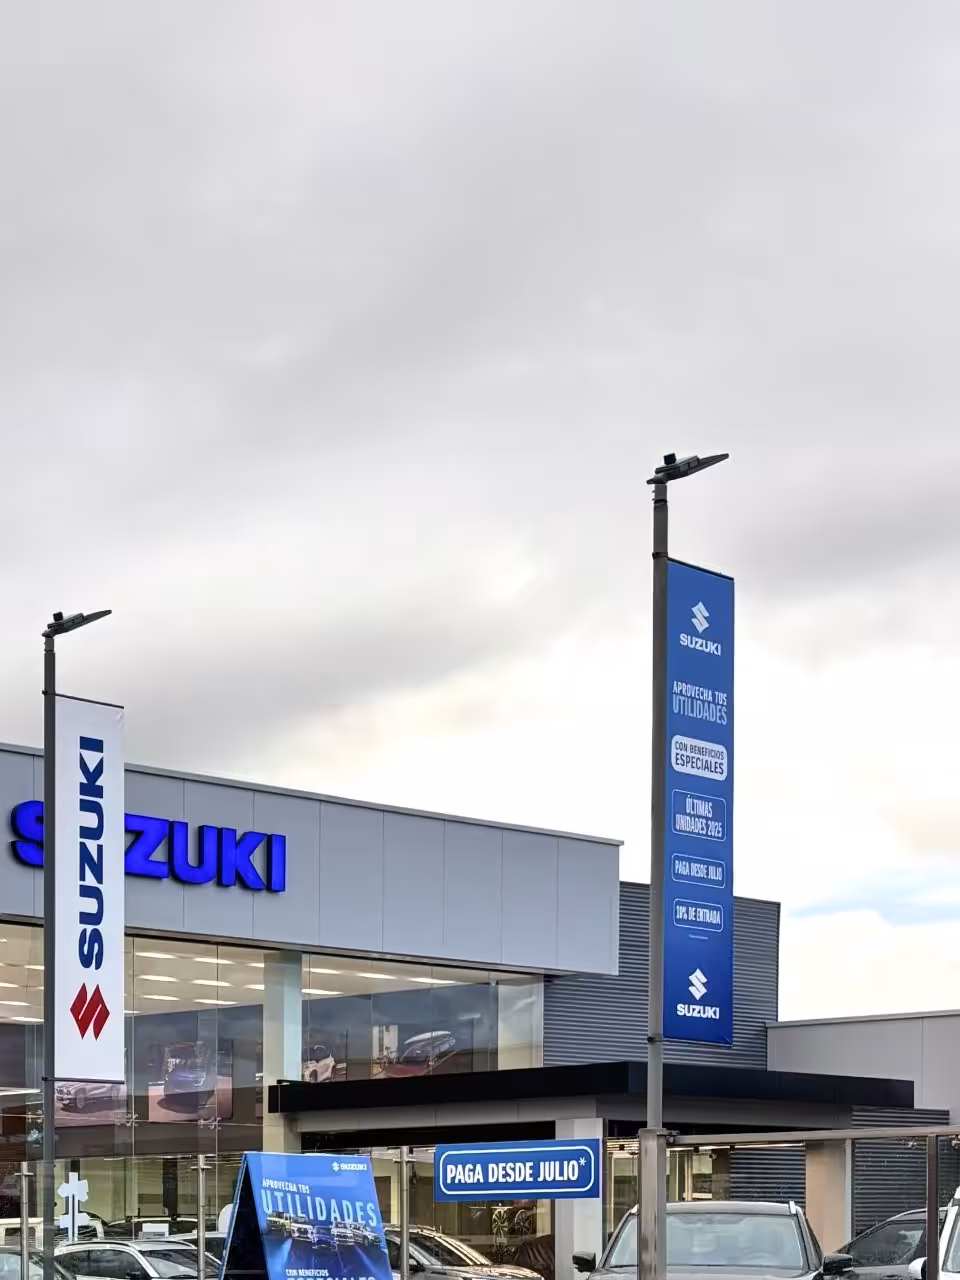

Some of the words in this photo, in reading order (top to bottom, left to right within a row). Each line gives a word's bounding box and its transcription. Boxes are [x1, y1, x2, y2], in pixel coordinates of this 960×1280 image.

[680, 633, 721, 656] SUZUKI
[672, 681, 712, 703] APROVECHA
[715, 691, 727, 706] TUS
[672, 694, 727, 725] UTILIDADES
[675, 741, 688, 752] CON
[690, 744, 724, 761] BENEFICIOS
[675, 752, 724, 775] ESPECIALES
[686, 795, 712, 818] ÚLTIMAS
[675, 814, 707, 835] UNIDADES
[708, 821, 722, 838] 2025
[11, 800, 286, 892] SZUKI
[78, 736, 104, 970] SUZUKI
[675, 860, 690, 876] PAGA
[691, 862, 707, 878] DESDE
[708, 864, 722, 880] JULIO
[676, 905, 687, 920] 10%
[689, 906, 696, 921] DE
[697, 908, 720, 925] ENTRADA
[677, 1003, 719, 1019] SUZUKI
[446, 1164, 484, 1184] PAGA
[488, 1162, 534, 1182] DESDE
[262, 1178, 298, 1192] APROVECHA
[299, 1184, 310, 1194] TUS
[261, 1189, 377, 1226] UTILIDADES
